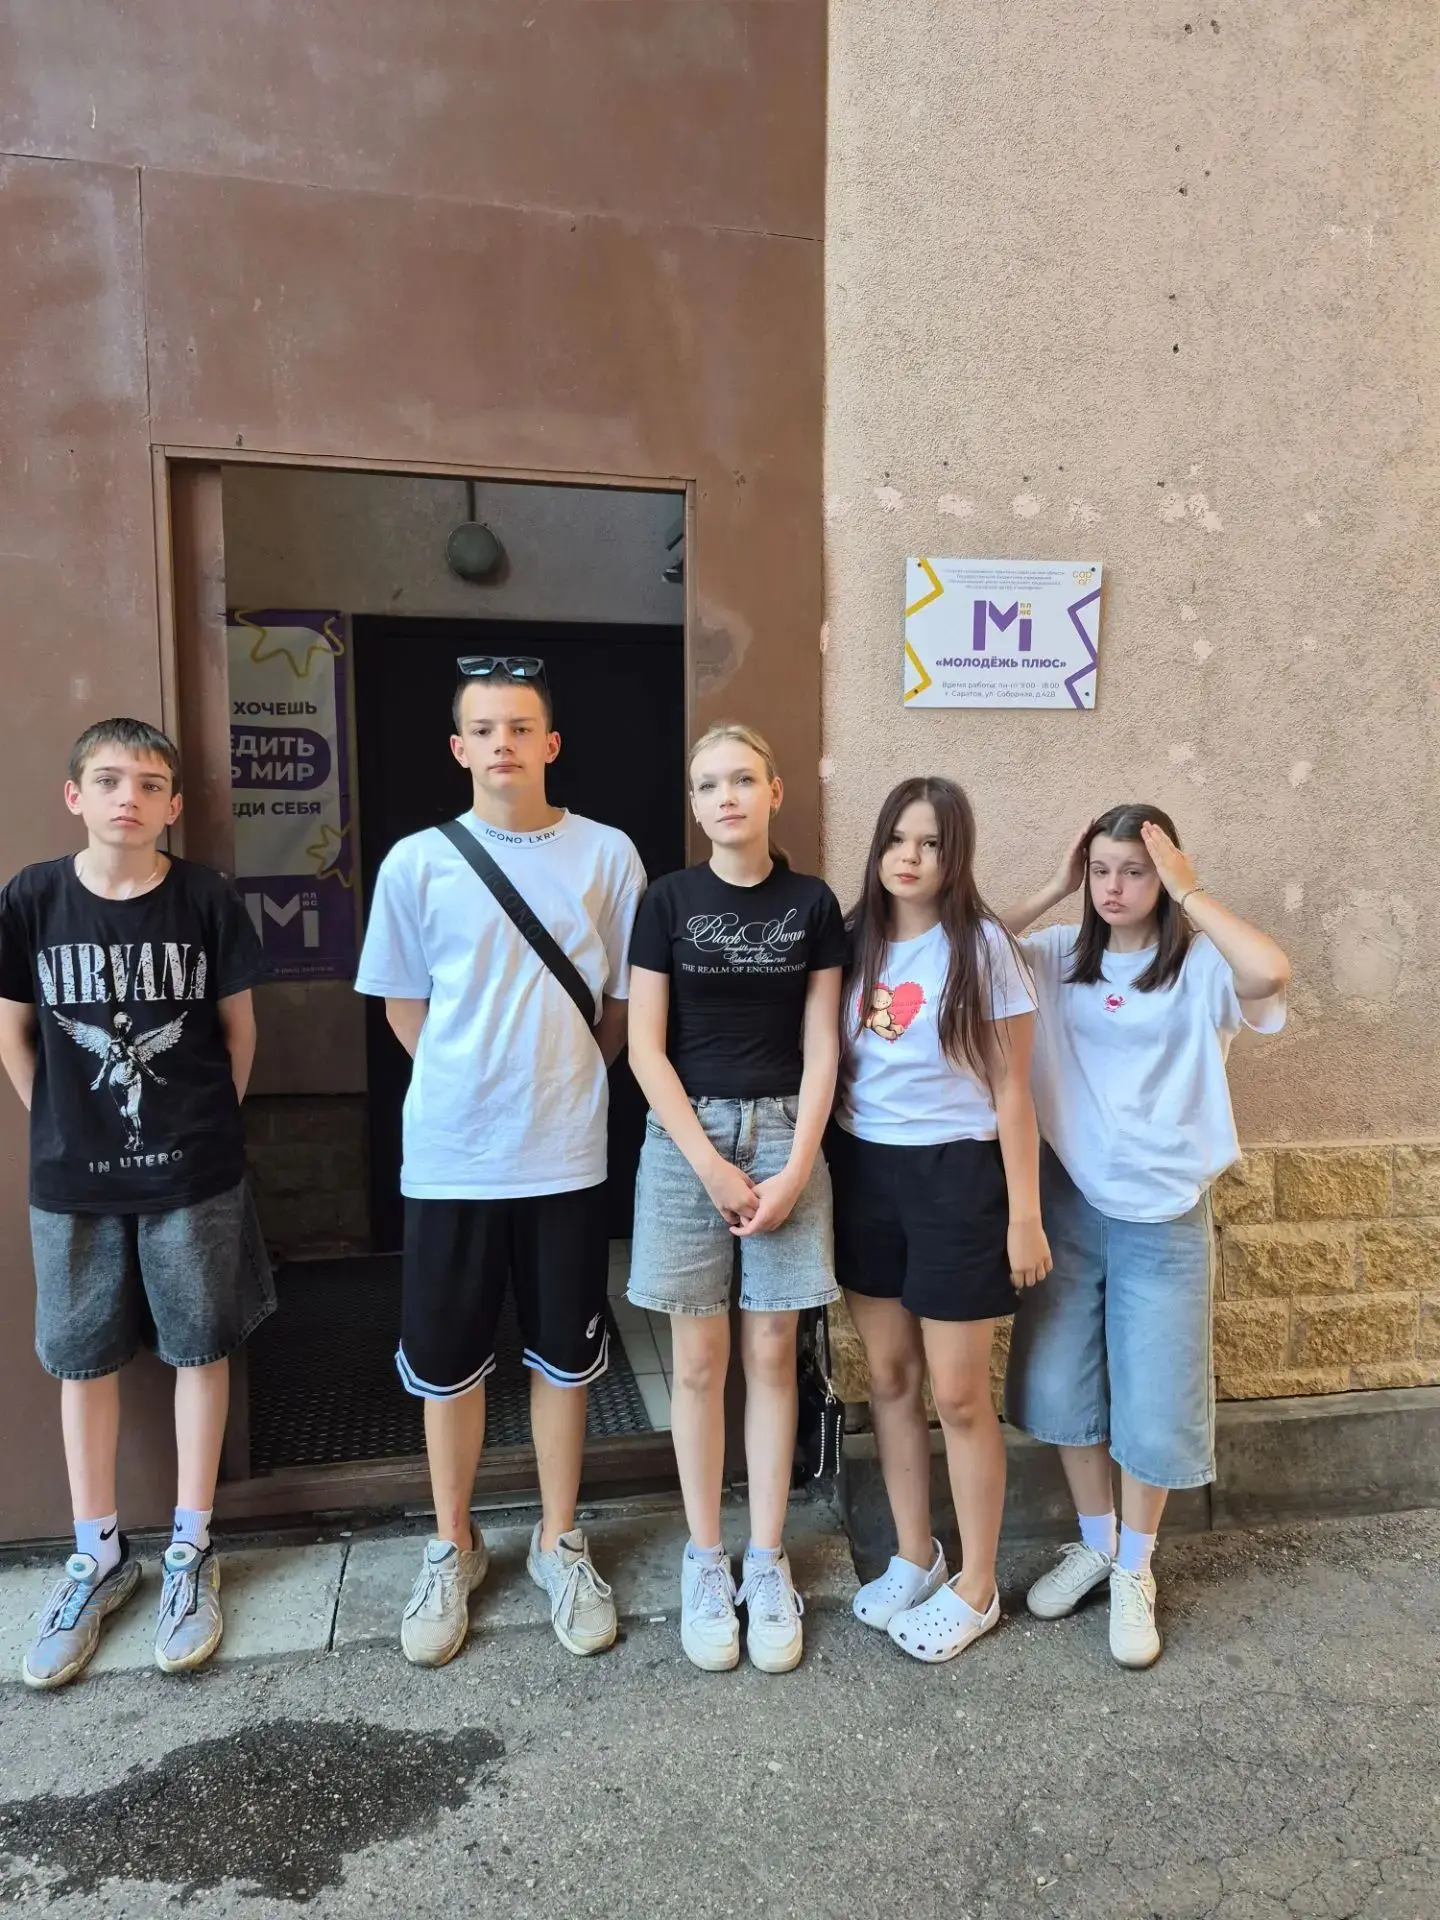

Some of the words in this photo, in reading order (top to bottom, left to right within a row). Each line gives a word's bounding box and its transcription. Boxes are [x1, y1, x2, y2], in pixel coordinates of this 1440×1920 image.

[935, 656, 1018, 669] «МОЛОДЁЖЬ
[1022, 658, 1067, 669] ПЛЮС»
[233, 701, 317, 715] ХОЧЕШЬ
[251, 761, 315, 781] МИР
[271, 801, 321, 815] СЕБЯ
[485, 828, 522, 844] ICONO
[529, 830, 556, 844] LXRY
[681, 912, 742, 952] Black
[741, 908, 805, 952] Swan
[37, 942, 209, 1007] NIRVANA
[681, 963, 696, 973] THE
[698, 965, 730, 974] REALM
[732, 964, 745, 973] OF
[746, 961, 807, 974] ENCHANTMENT
[89, 1160, 111, 1174] IN
[119, 1149, 184, 1169] UTERO
